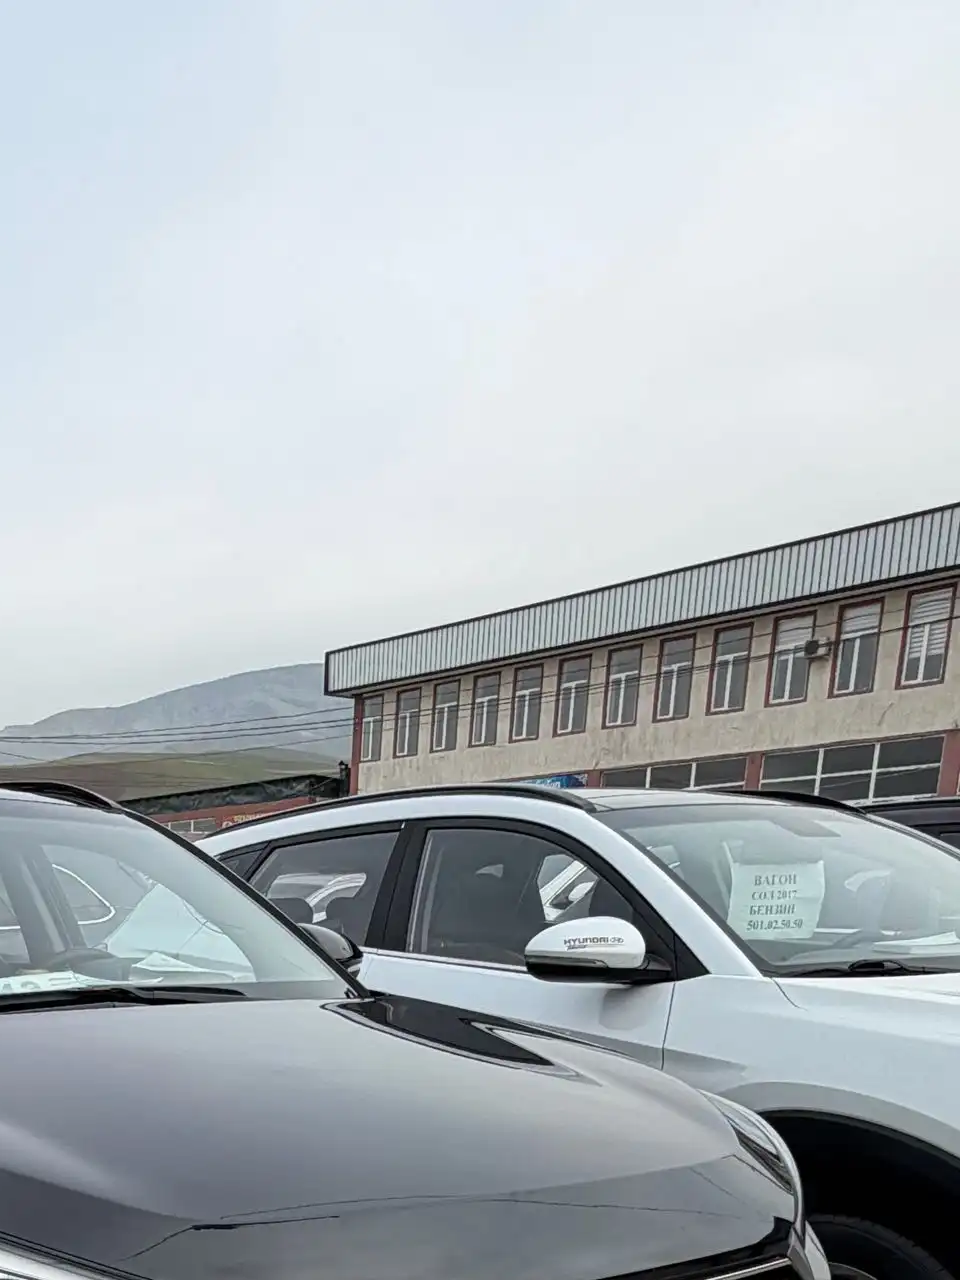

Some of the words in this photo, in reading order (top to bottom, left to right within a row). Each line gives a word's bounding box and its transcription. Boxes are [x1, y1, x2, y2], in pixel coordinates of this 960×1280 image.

[754, 874, 797, 886] ВАГОН
[749, 904, 795, 916] БЕНЗИН
[564, 936, 609, 946] HYUNDAI
